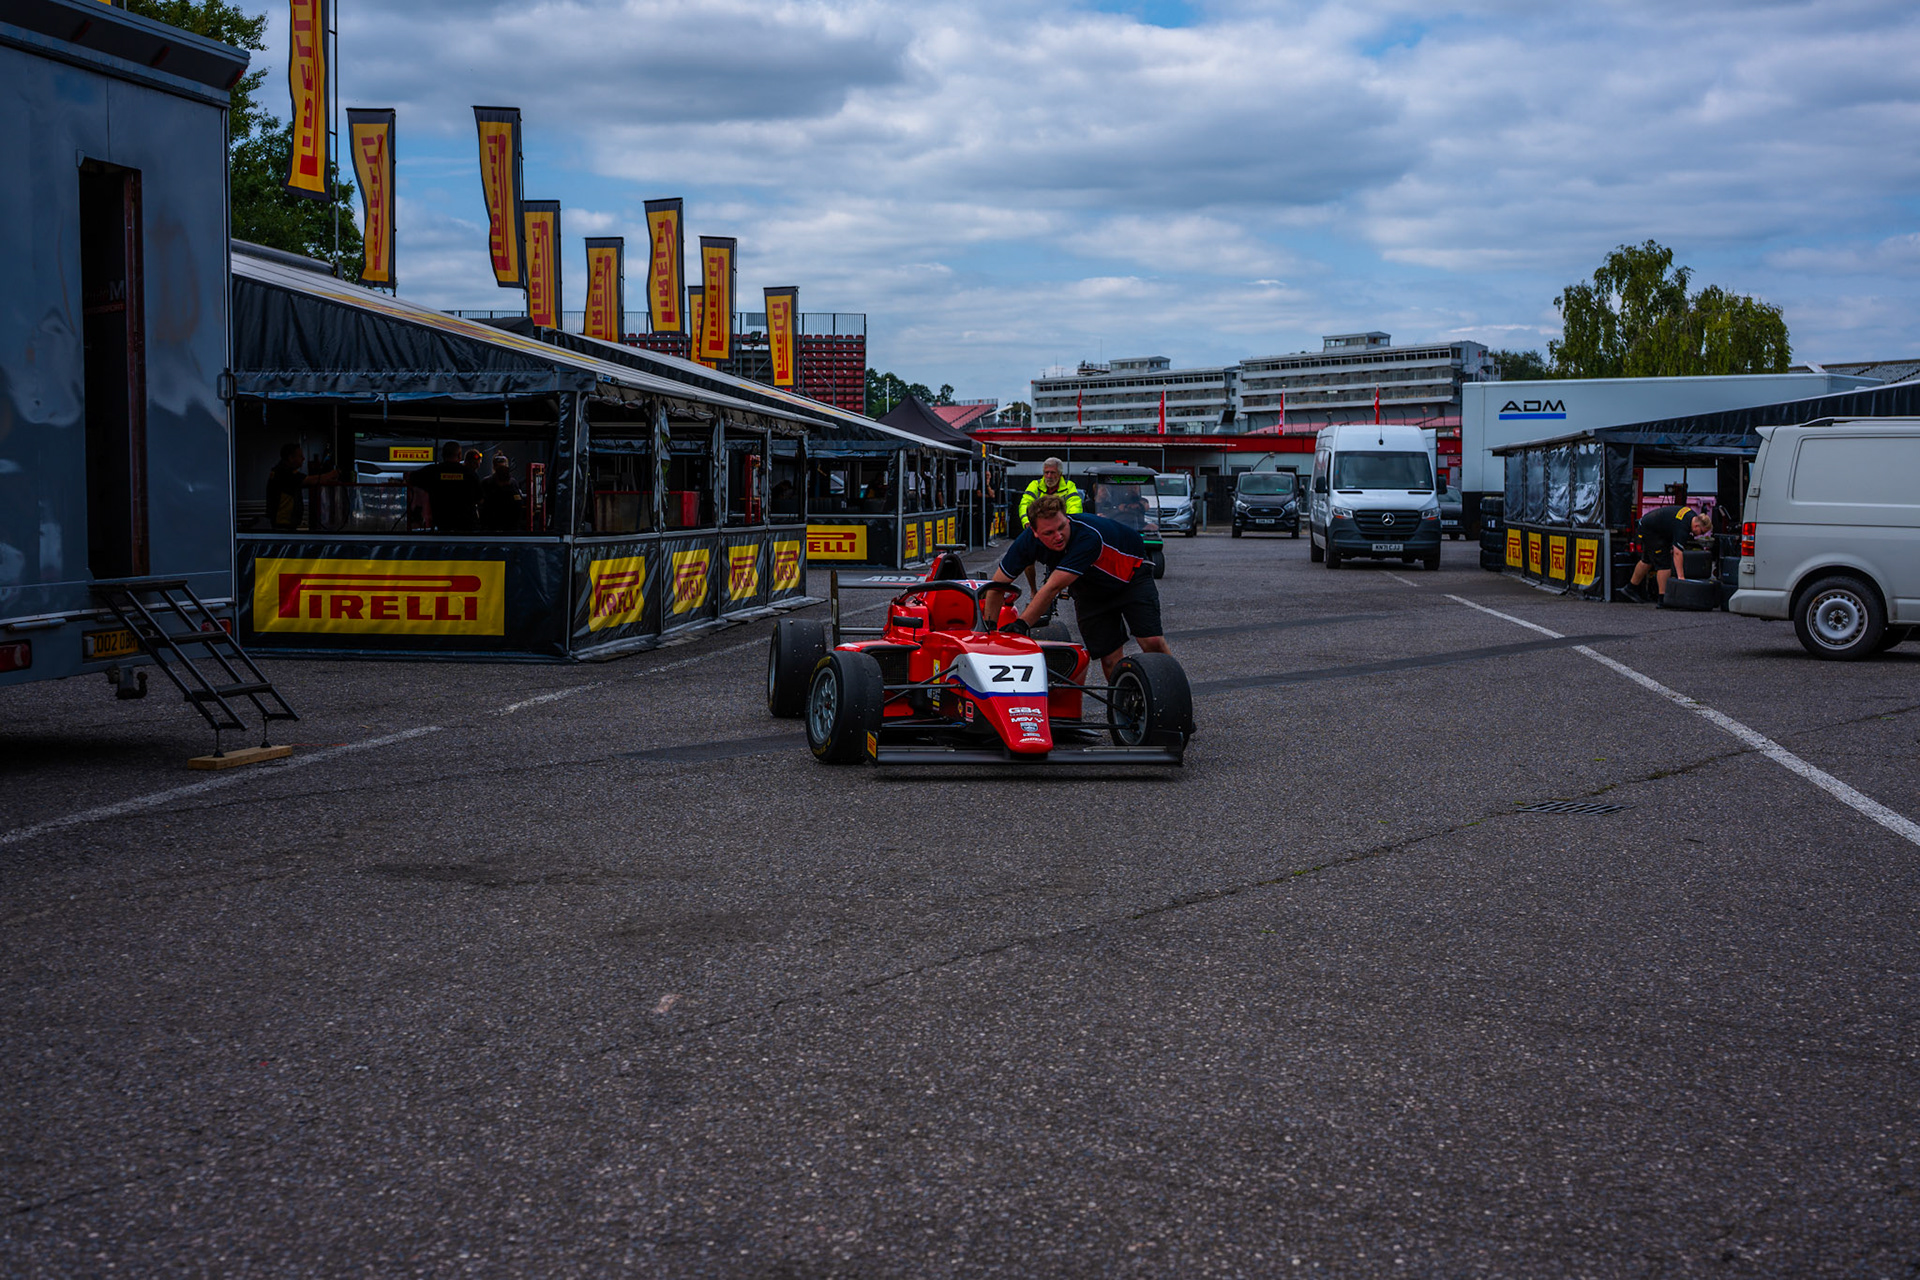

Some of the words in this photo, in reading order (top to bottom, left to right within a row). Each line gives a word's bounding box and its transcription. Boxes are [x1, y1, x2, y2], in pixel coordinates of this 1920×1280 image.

[1499, 399, 1566, 412] ADM
[393, 450, 430, 459] PIRELLI
[807, 533, 857, 552] ELLI
[278, 573, 482, 621] PIRELLI
[594, 570, 640, 617] PIRELLI
[989, 665, 1034, 682] 27
